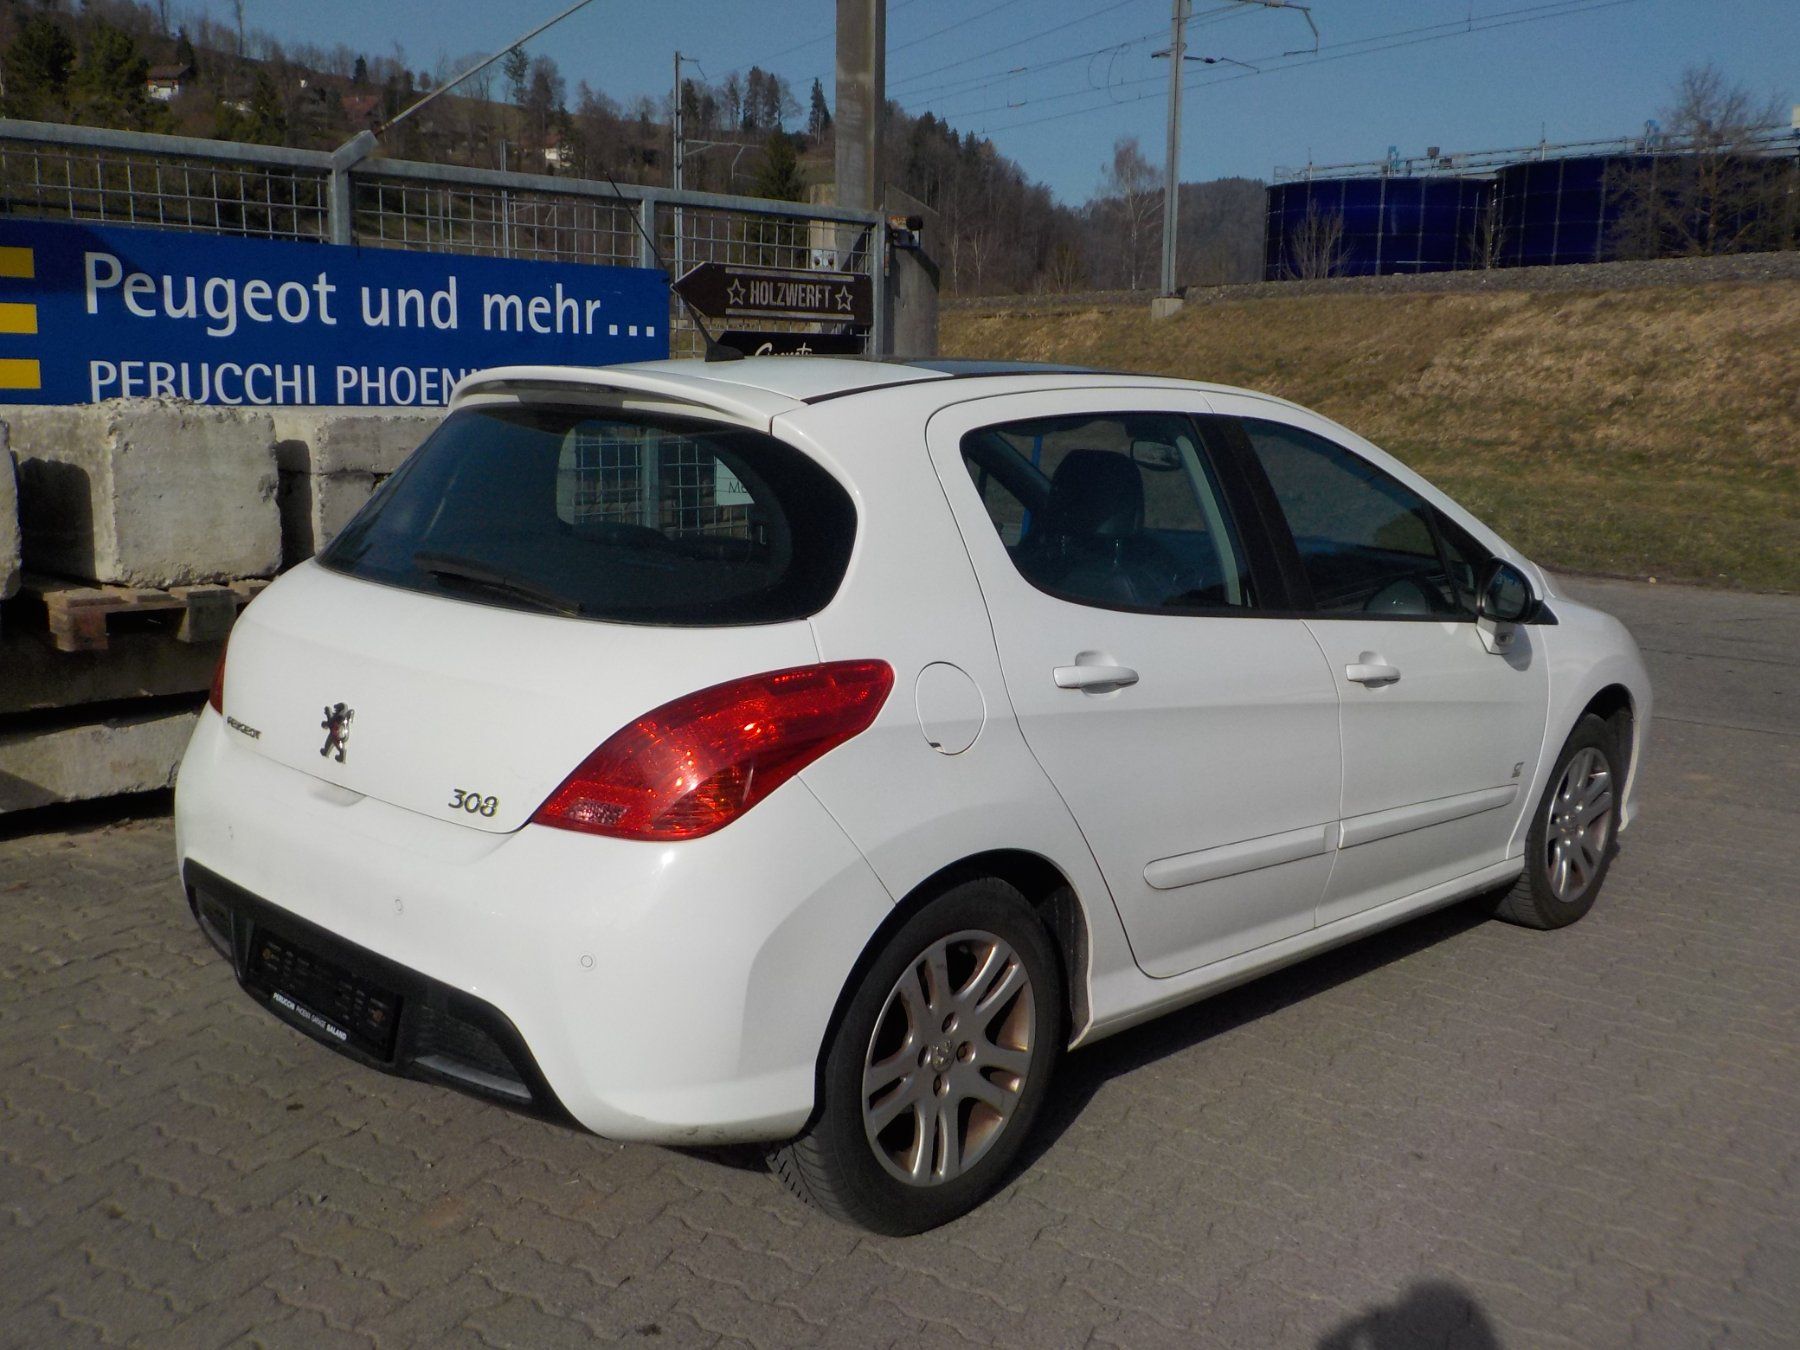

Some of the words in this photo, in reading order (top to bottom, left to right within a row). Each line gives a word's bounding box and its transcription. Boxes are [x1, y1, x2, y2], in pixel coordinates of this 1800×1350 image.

[84, 251, 337, 337] Peugeot
[362, 276, 458, 330] und
[483, 283, 656, 337] mehr...
[750, 281, 832, 309] HOLZWERFT
[90, 360, 316, 404] PERUCCHI
[337, 366, 486, 405] PHOEN
[448, 789, 499, 817] 308
